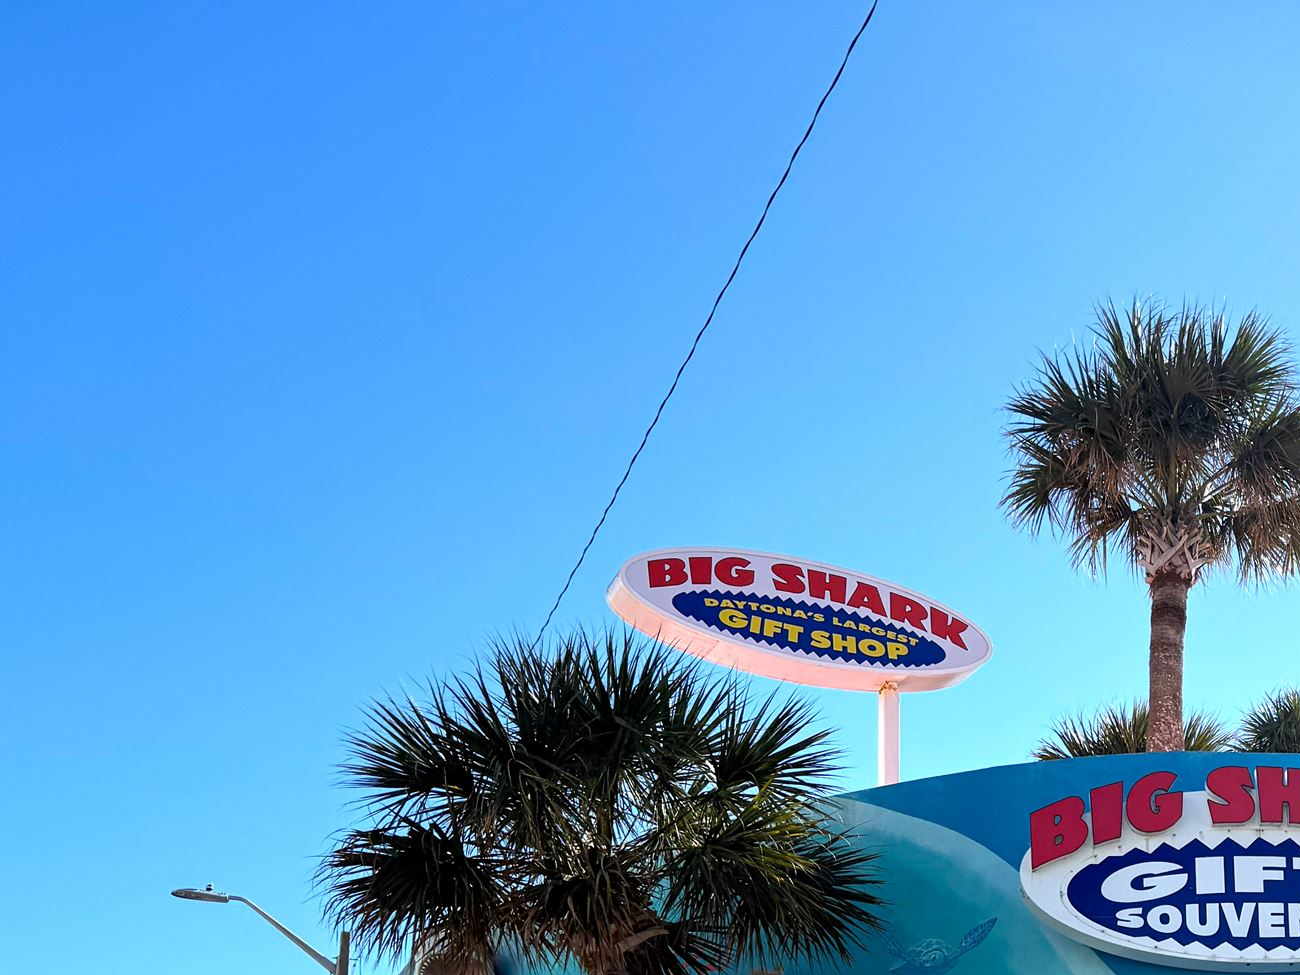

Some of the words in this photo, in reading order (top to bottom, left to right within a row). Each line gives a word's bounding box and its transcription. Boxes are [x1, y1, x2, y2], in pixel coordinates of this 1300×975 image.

[647, 556, 755, 588] BIG
[770, 563, 969, 651] SHARK
[703, 598, 825, 622] DAYTONA'S
[832, 617, 920, 647] LARGEST
[718, 608, 804, 644] GIFT
[810, 631, 910, 661] SHOP
[1030, 771, 1183, 871] BIG
